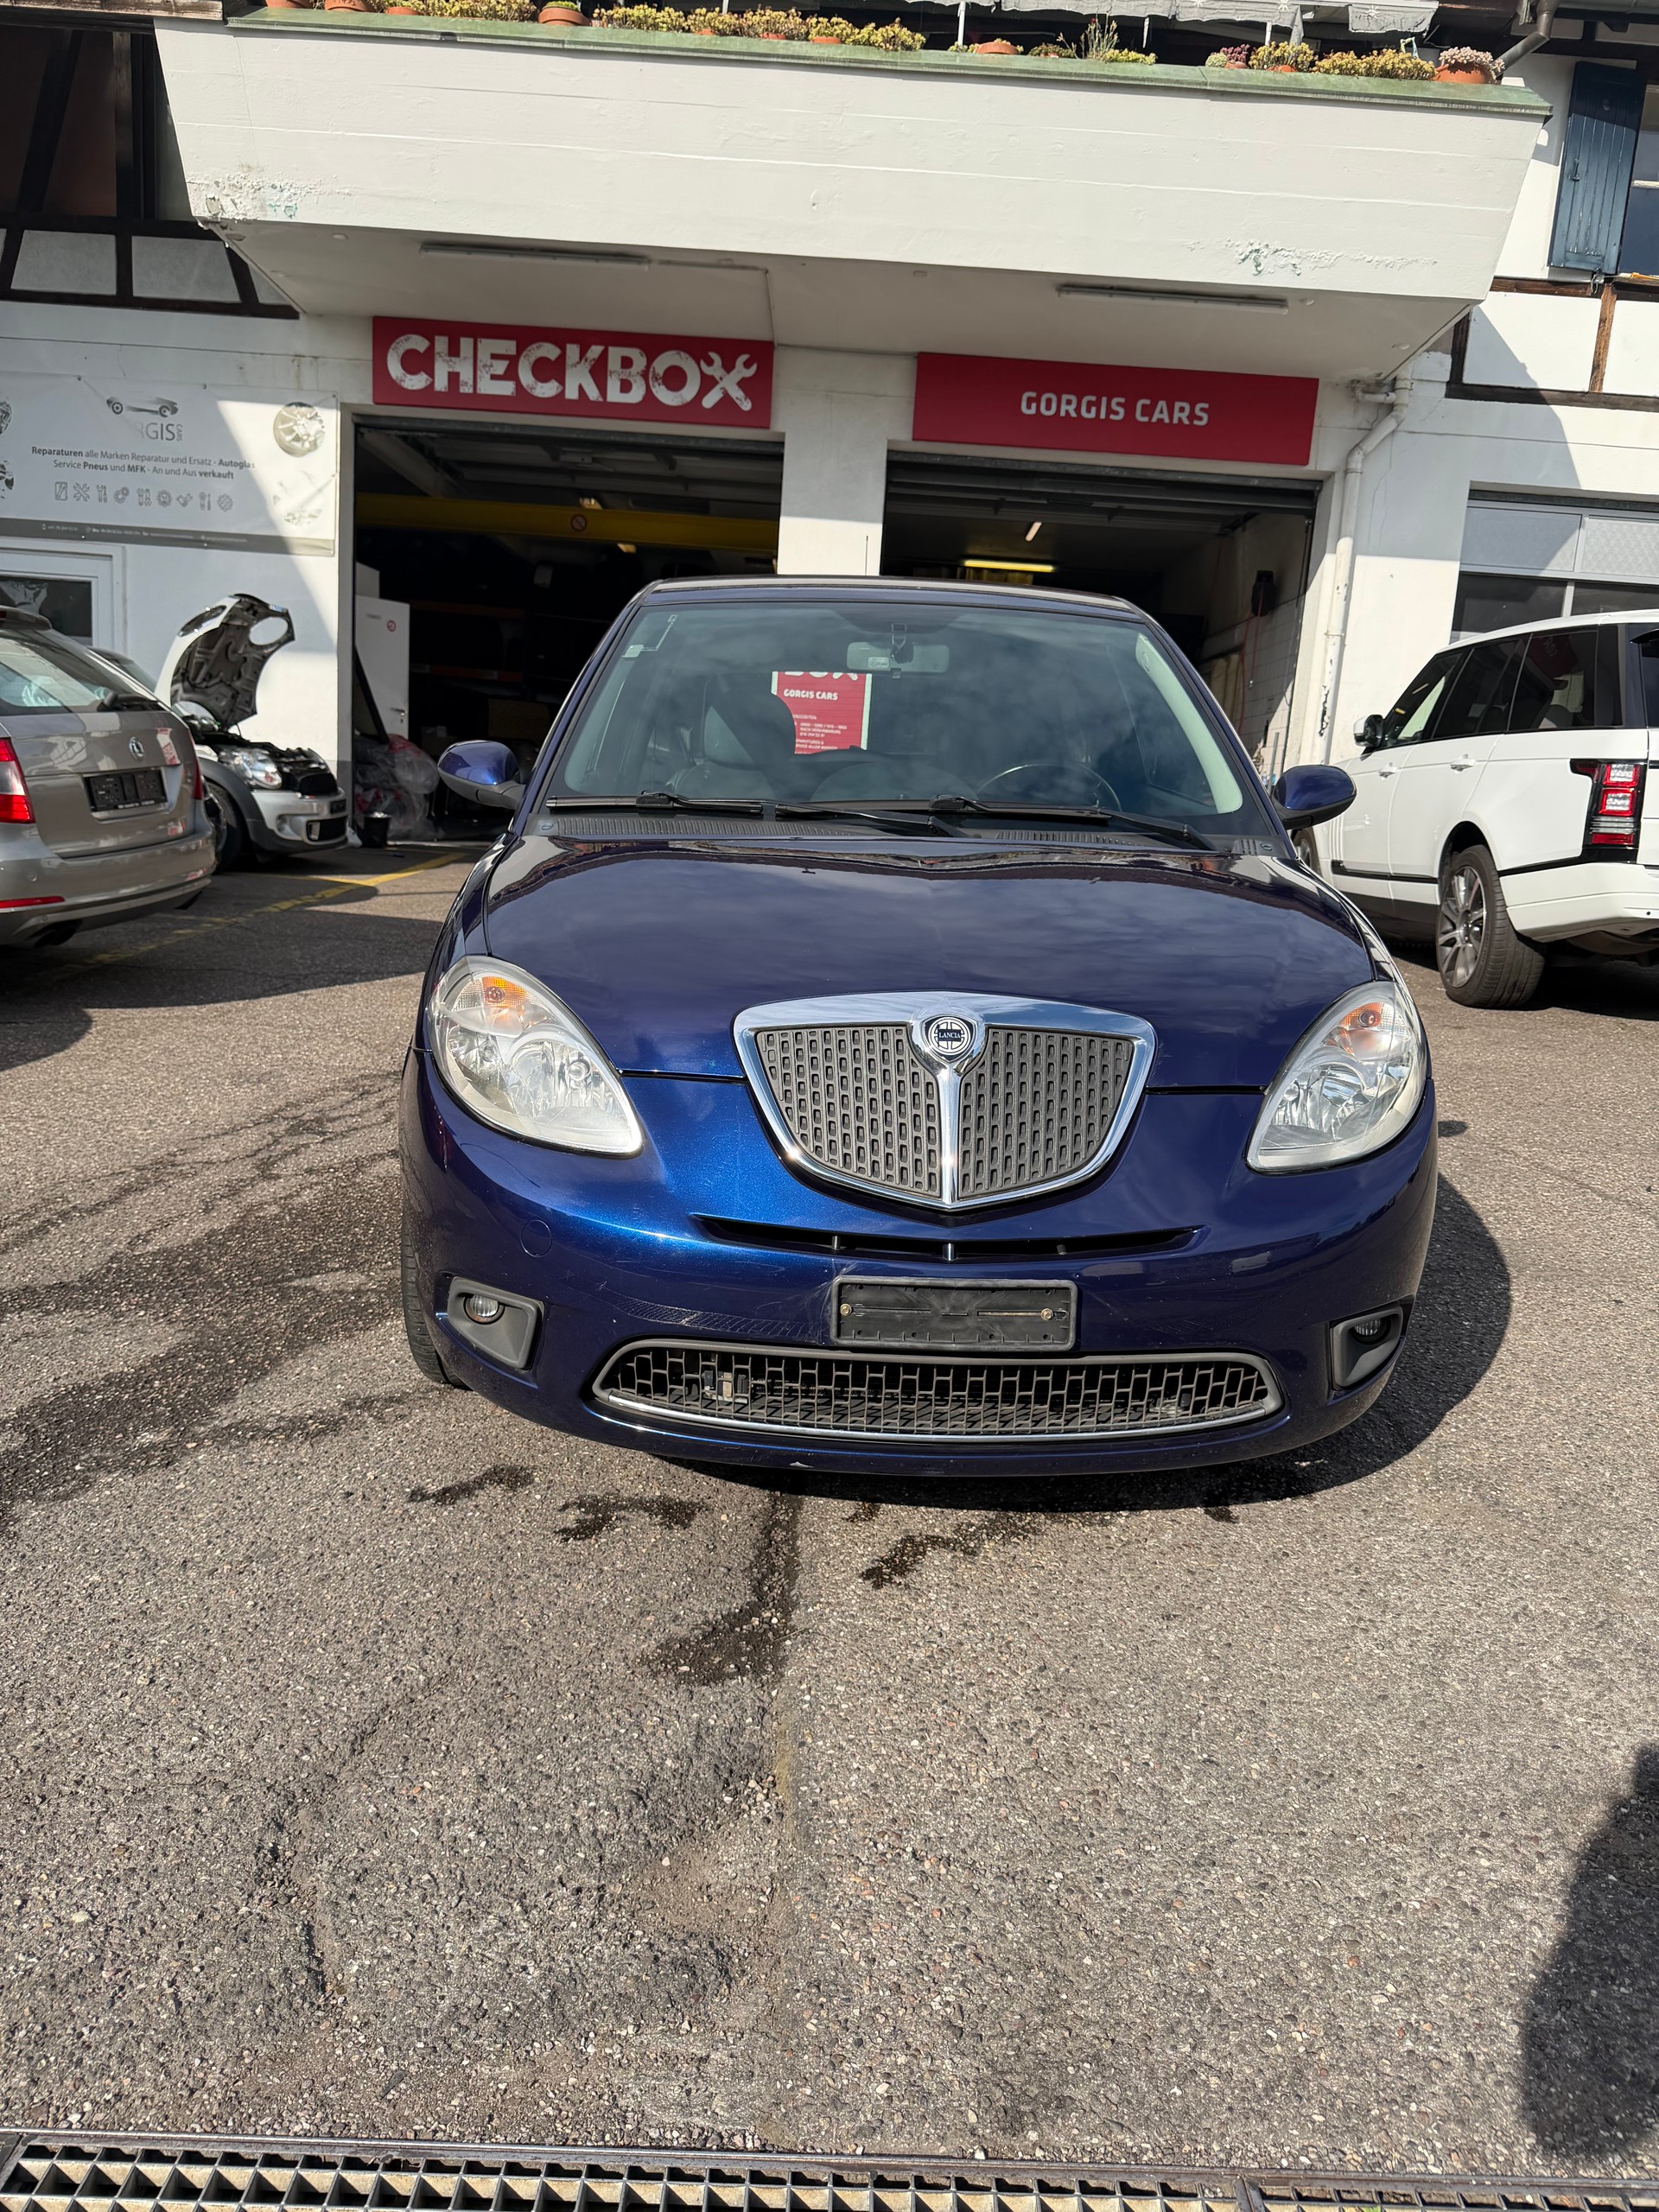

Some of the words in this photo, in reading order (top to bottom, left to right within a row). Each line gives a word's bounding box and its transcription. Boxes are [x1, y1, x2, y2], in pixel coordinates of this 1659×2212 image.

[386, 333, 758, 412] CHECKBOX
[1020, 391, 1126, 421] GORGIS
[1135, 398, 1209, 426] CARS
[31, 446, 84, 456] Reparaturen
[85, 449, 99, 459] alle
[100, 450, 130, 461] Marken
[130, 452, 169, 463] Reparatur
[171, 455, 188, 465] und
[188, 456, 213, 467] Ersatz
[53, 459, 82, 469] Service
[83, 461, 109, 471] Pneus
[110, 463, 126, 473] und
[127, 464, 146, 474] MFK
[152, 466, 163, 474] An
[164, 467, 181, 476] und
[182, 467, 197, 477] Aus
[198, 468, 234, 480] verkauft
[783, 688, 815, 699] GORGIS
[815, 690, 838, 701] CARS
